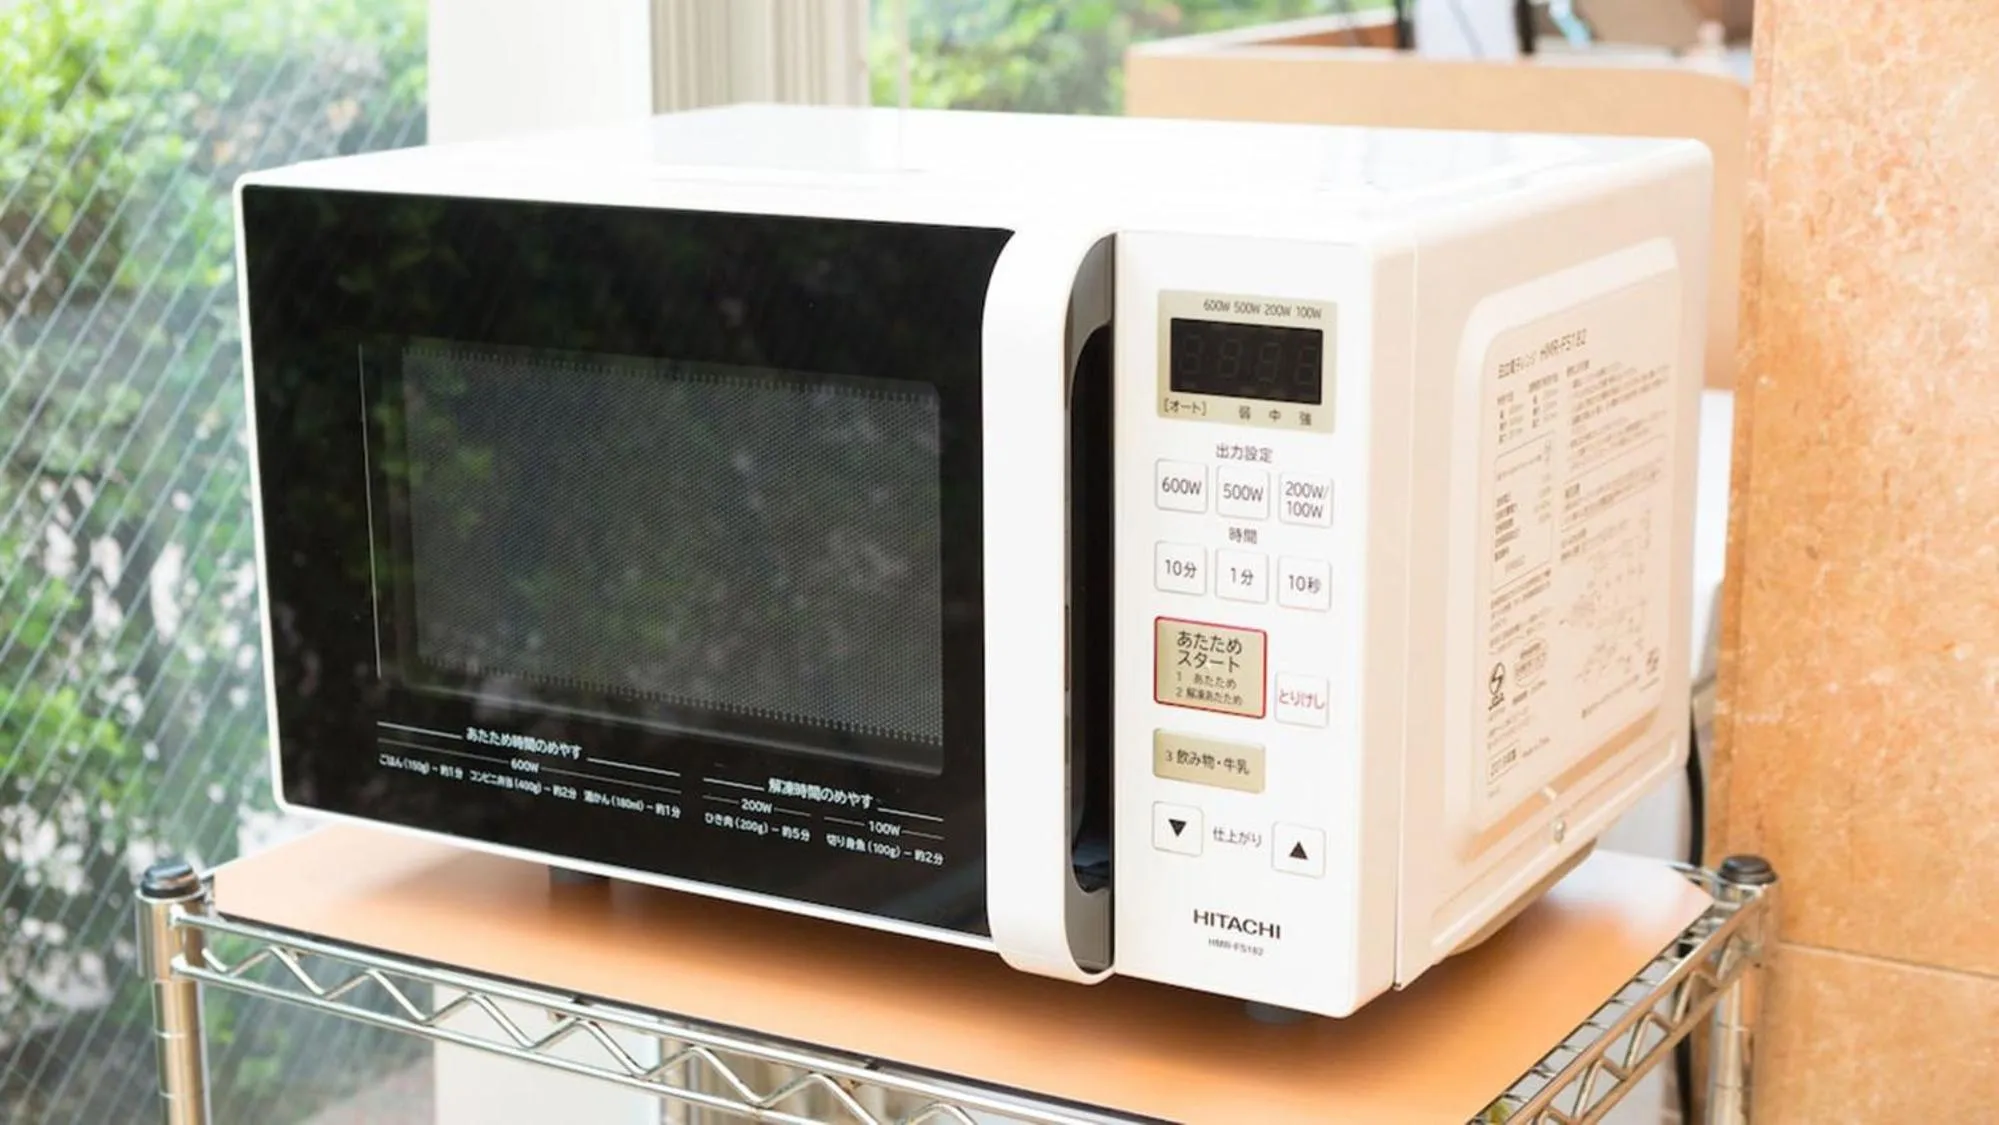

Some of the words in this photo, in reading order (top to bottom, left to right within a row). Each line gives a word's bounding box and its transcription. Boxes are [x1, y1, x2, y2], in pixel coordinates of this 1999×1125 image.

[1203, 299, 1231, 312] 600W
[1234, 302, 1261, 315] 500W
[1264, 304, 1291, 317] 200W
[1296, 306, 1322, 319] 100W
[1269, 409, 1281, 421] 中
[1216, 443, 1273, 464] 出力設定
[1161, 477, 1202, 496] 600W
[1223, 484, 1263, 502] 500W
[1285, 481, 1329, 499] 200W/
[1287, 500, 1323, 518] 100W
[1229, 528, 1257, 544] 時間
[1165, 559, 1197, 579] 10分
[1231, 567, 1254, 586] 1分
[1289, 575, 1322, 594] 10秒
[1177, 630, 1242, 656] あたため
[1177, 649, 1240, 673] スタート
[1194, 673, 1237, 689] あたため
[1186, 687, 1243, 706] 解凍あたため
[1279, 689, 1325, 710] とりけし
[466, 726, 582, 759] あたため時間のめやす
[511, 758, 539, 773] 600W
[1176, 749, 1250, 775] 飲み物・牛乳
[768, 777, 873, 809] 解凍時間のめやす
[741, 799, 772, 814] 200W
[869, 821, 901, 836] 100W
[1213, 826, 1263, 848] 仕上がり
[1193, 908, 1281, 939] HITACHI
